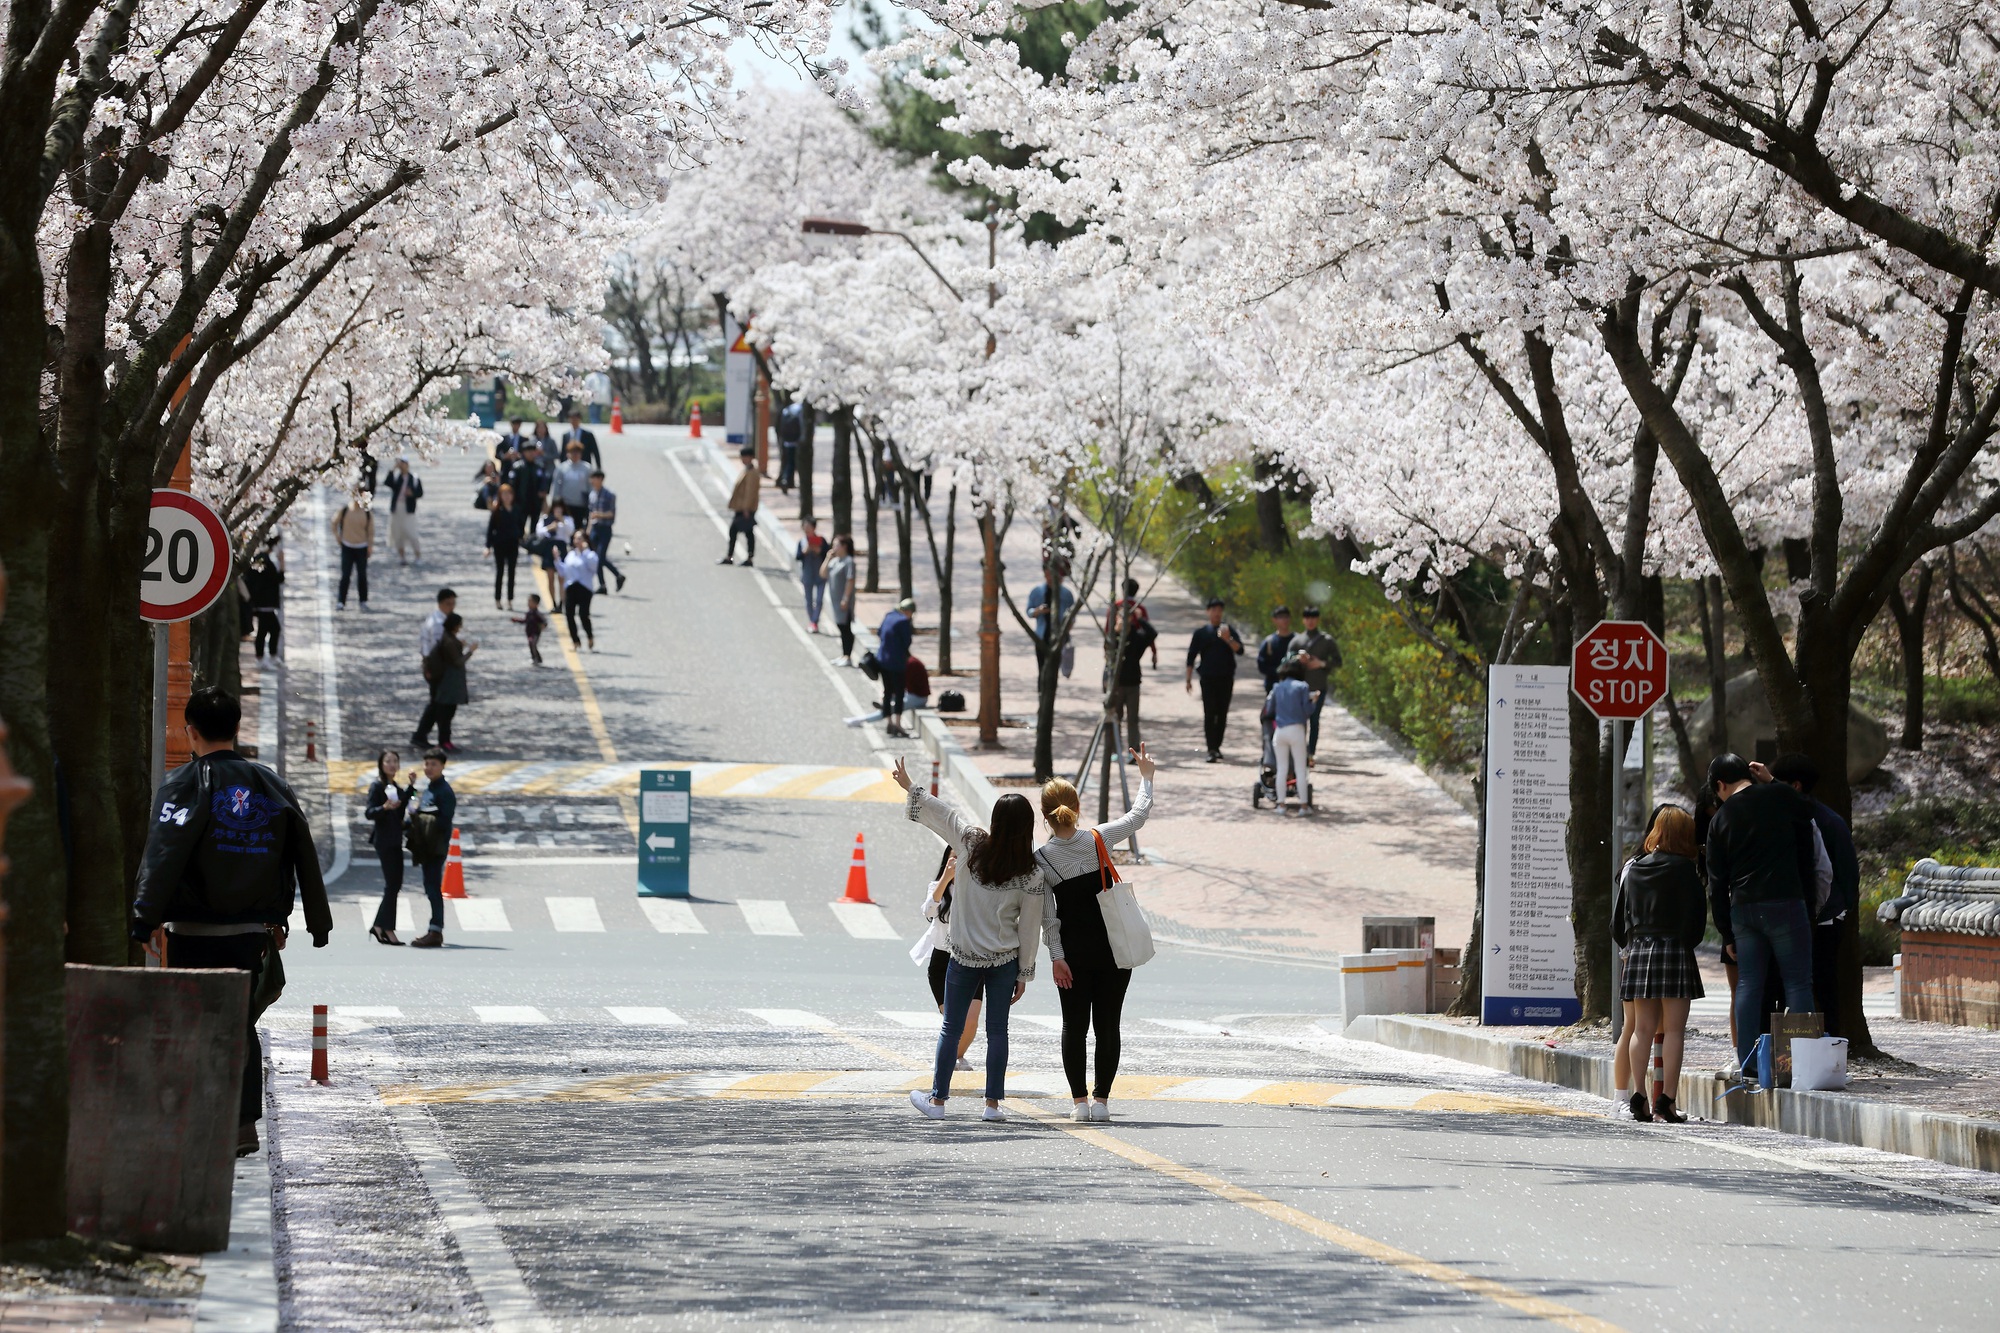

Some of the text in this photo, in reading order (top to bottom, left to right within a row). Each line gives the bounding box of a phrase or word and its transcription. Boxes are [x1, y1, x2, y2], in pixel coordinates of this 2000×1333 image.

[140, 527, 198, 584] 20
[1589, 638, 1654, 672] 정지
[1589, 679, 1653, 704] STOP
[159, 802, 189, 826] 54
[1512, 811, 1565, 819] 음악공연예술대학
[1511, 881, 1563, 889] 첨단산업지원센터
[1509, 973, 1555, 981] 첨단건설재료관
